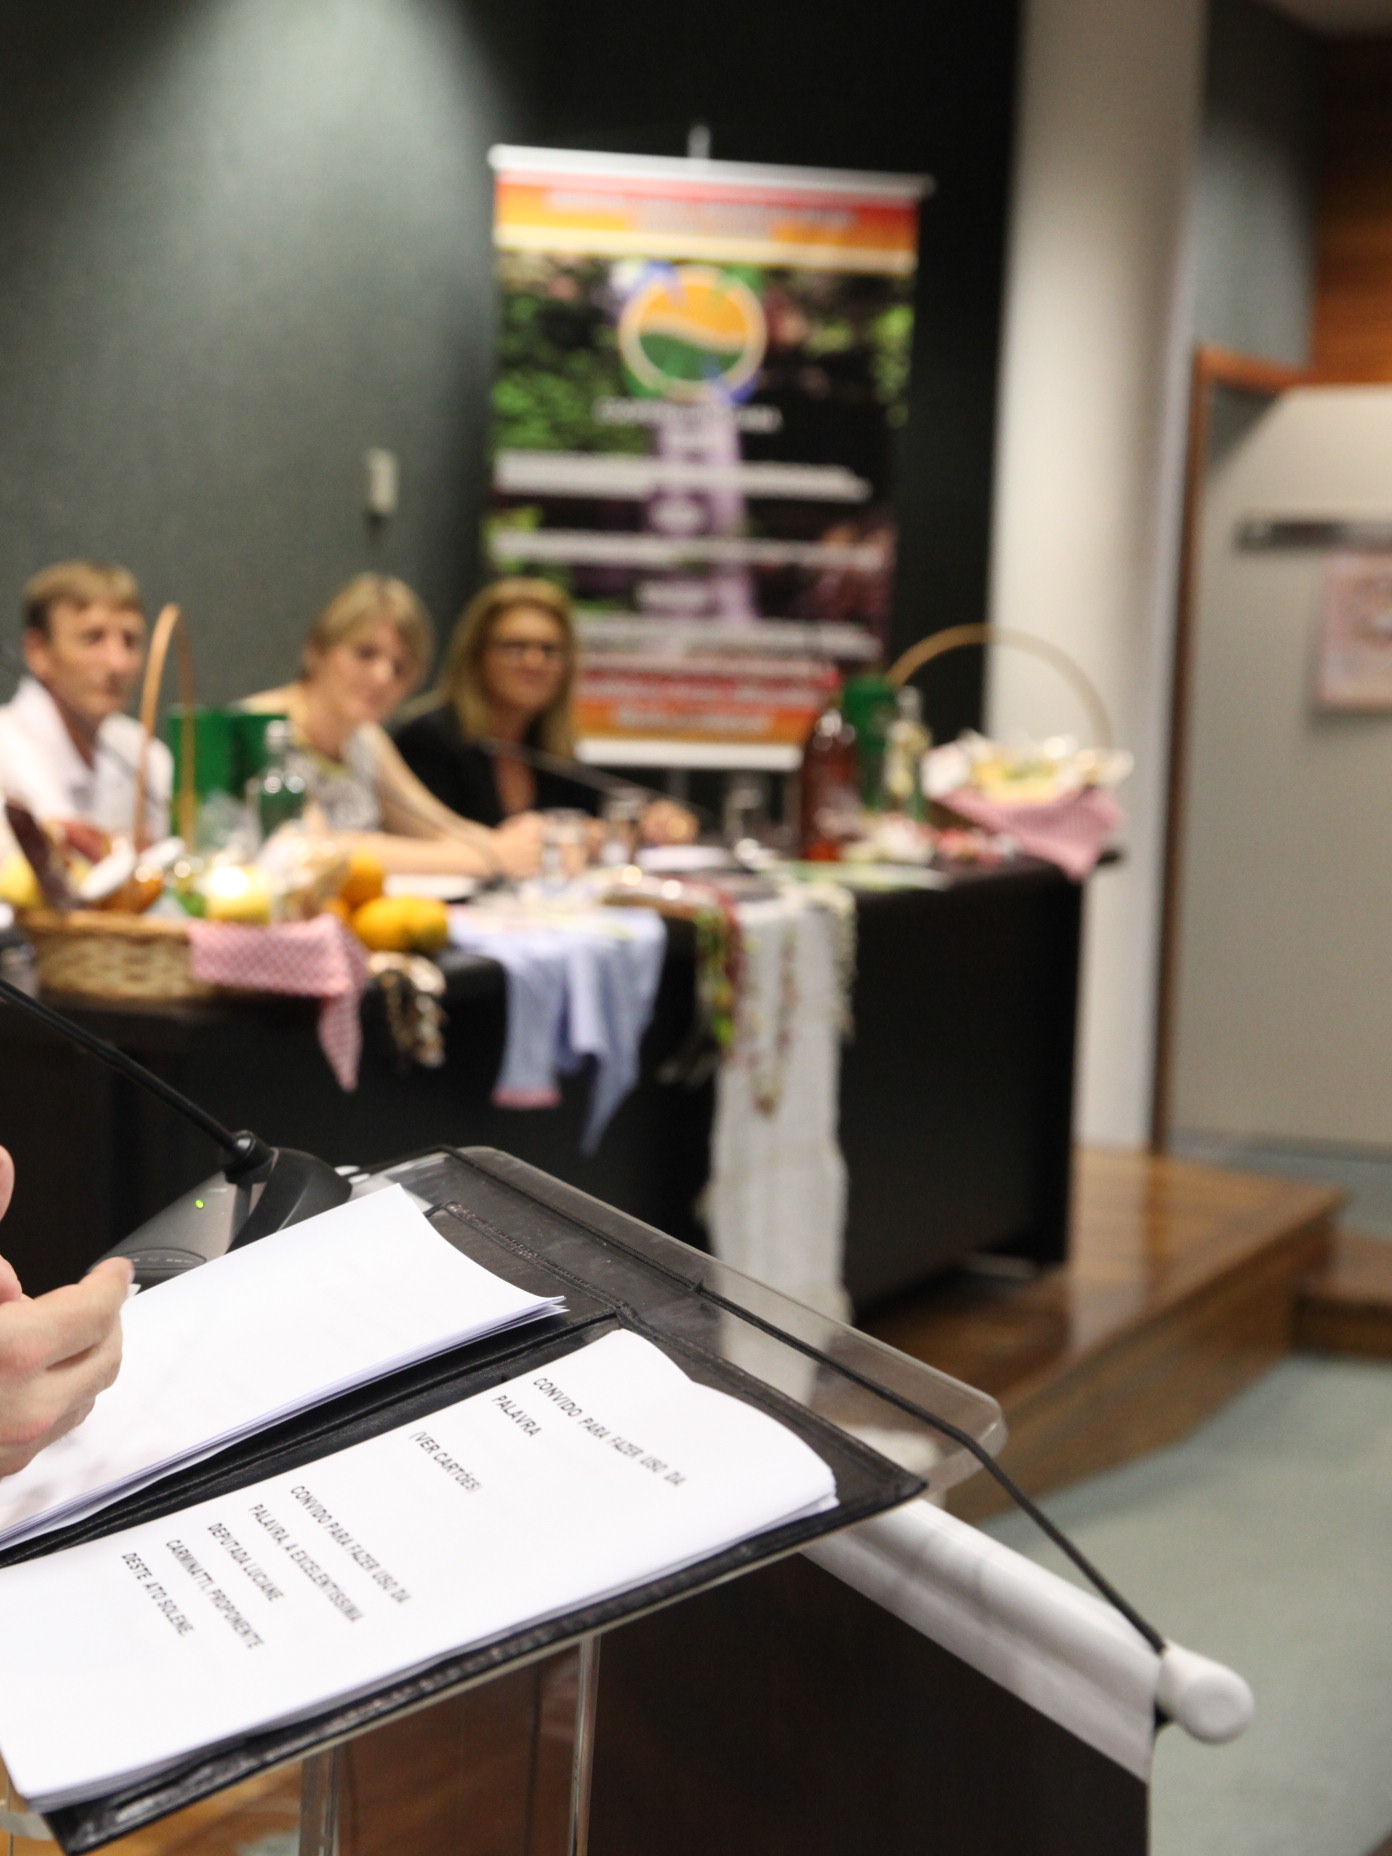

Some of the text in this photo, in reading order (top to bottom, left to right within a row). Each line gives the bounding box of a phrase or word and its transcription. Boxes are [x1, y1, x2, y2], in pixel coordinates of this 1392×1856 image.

[408, 1431, 440, 1455] (VER
[492, 1394, 542, 1438] PALAVRA
[533, 1377, 688, 1488] CONVIDO PARA FAZER USO DA
[248, 1503, 290, 1546] PALAVRA,
[284, 1542, 300, 1555] A
[290, 1484, 412, 1605] CONVIDO PARA FAZER USO DA
[121, 1551, 153, 1582] DESTE
[144, 1581, 168, 1601] ATO
[207, 1522, 285, 1603] DEPUTADA LUCIANE
[207, 1588, 265, 1650] PROPONENTE
